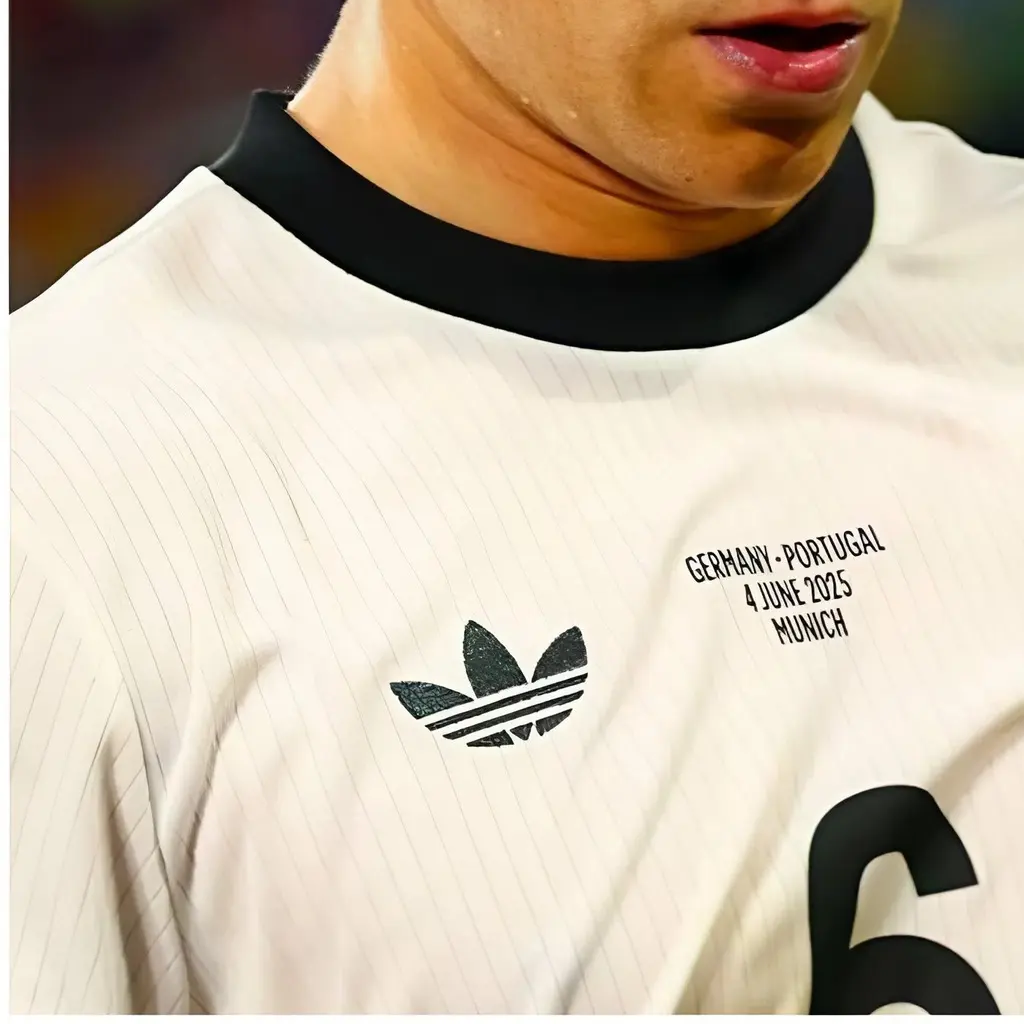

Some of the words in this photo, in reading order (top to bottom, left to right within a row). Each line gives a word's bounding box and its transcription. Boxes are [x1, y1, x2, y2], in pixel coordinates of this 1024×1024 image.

[685, 545, 772, 583] GERMANY
[781, 525, 885, 570] PORTUGAL
[744, 584, 758, 613] 4
[757, 578, 806, 610] JUNE
[804, 569, 852, 603] 2025
[771, 607, 848, 645] MUNICH
[808, 785, 1001, 1015] 6
